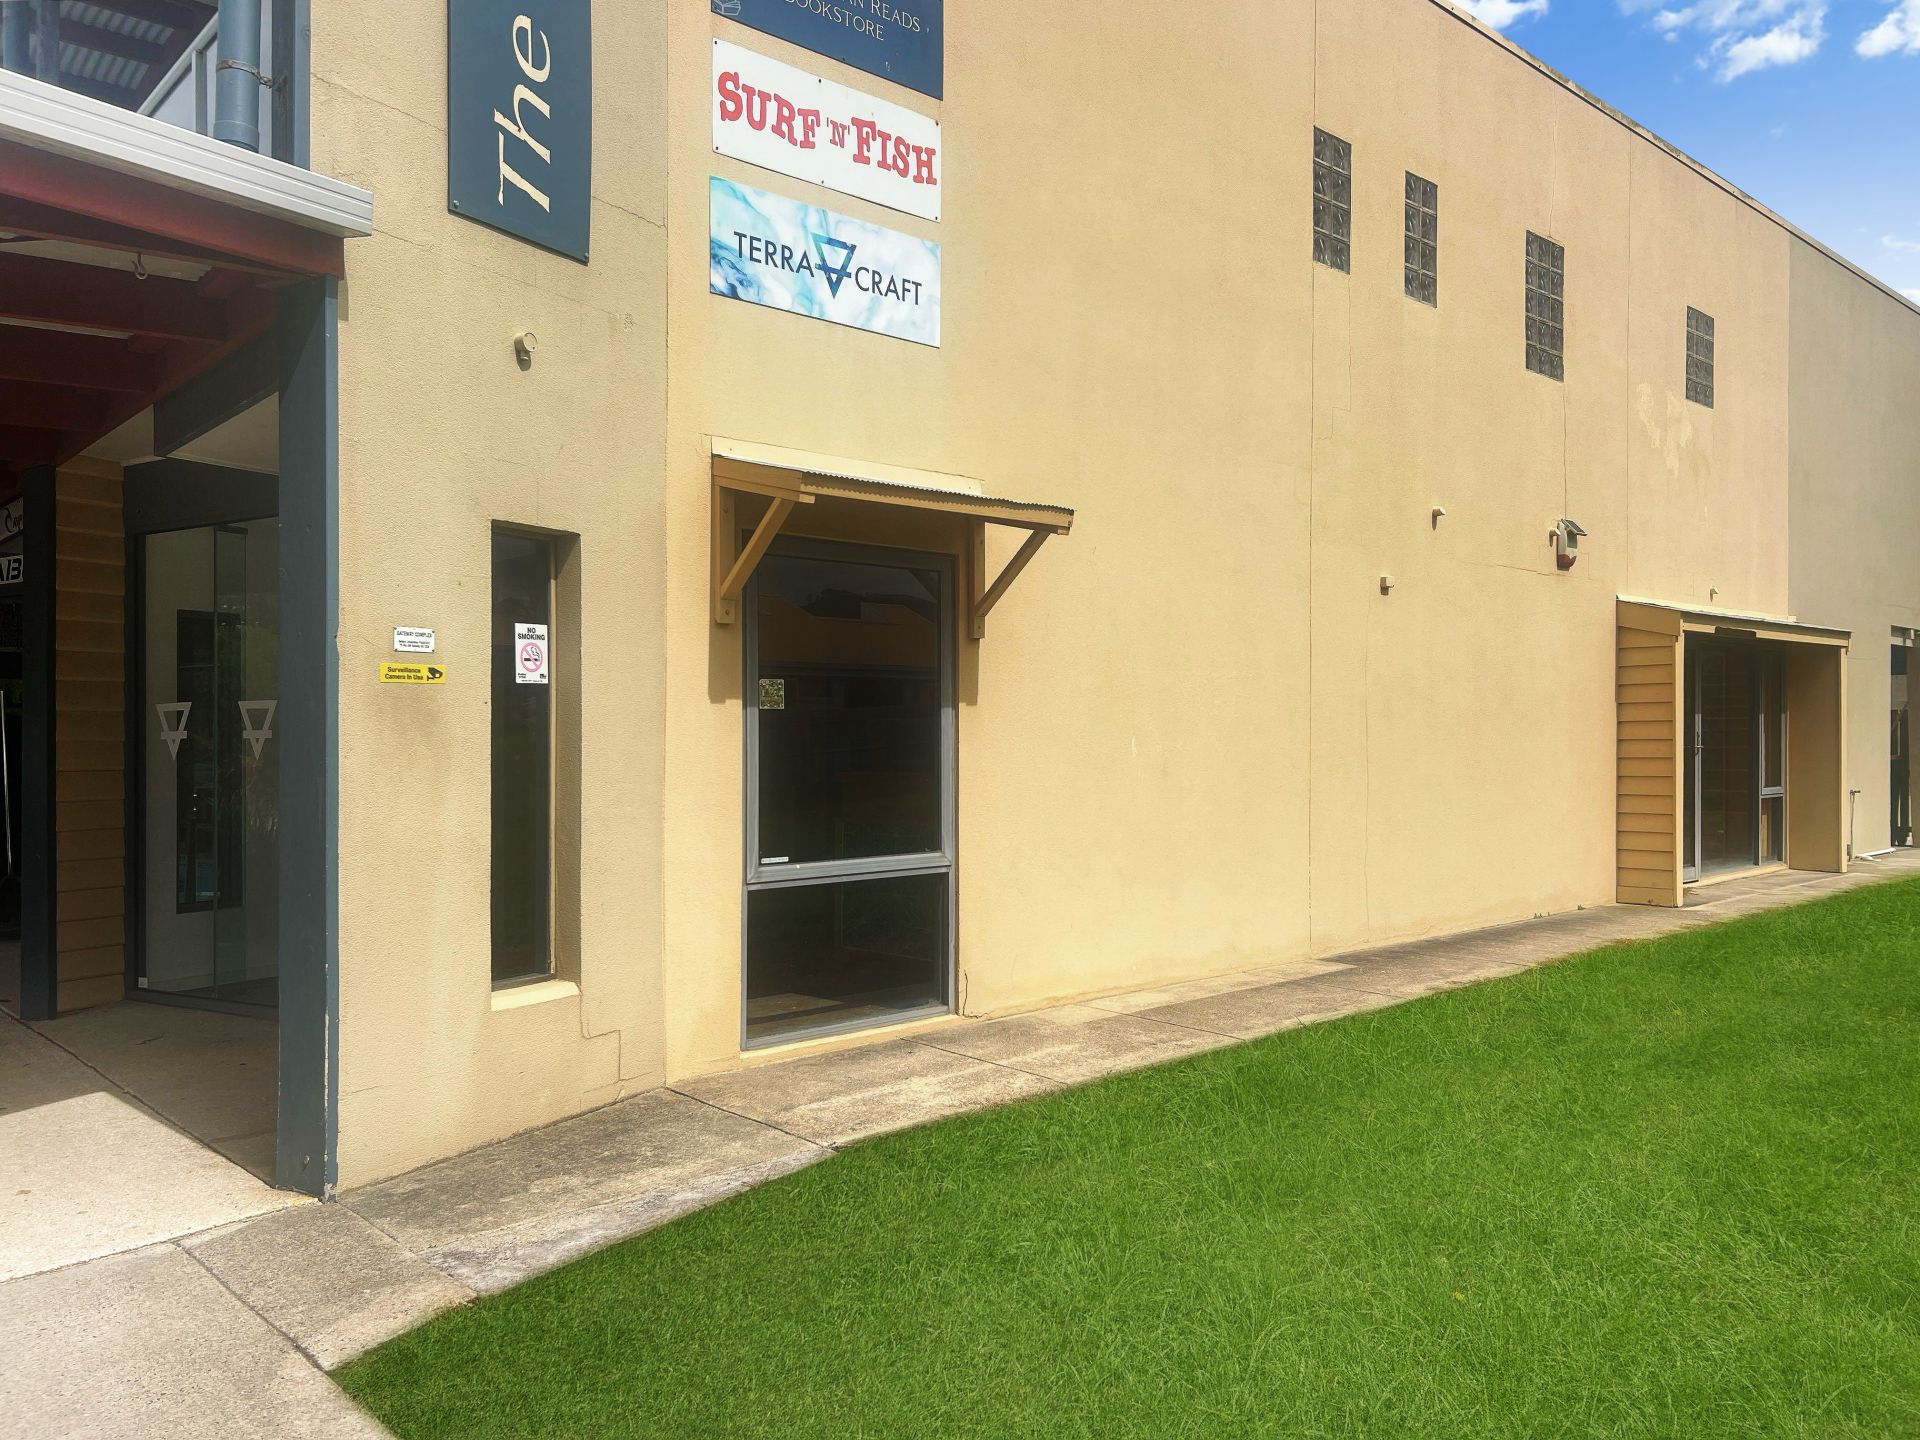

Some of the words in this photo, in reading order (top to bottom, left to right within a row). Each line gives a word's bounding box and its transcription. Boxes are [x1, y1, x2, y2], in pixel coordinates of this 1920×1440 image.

[785, 0, 884, 41] OOKSTORE
[871, 0, 921, 32] READS
[493, 14, 551, 213] The
[717, 71, 821, 149] SURF
[851, 116, 938, 185] FISH
[733, 231, 815, 278] TERRA
[855, 266, 922, 305] CRAFT
[517, 633, 546, 641] SMOKING
